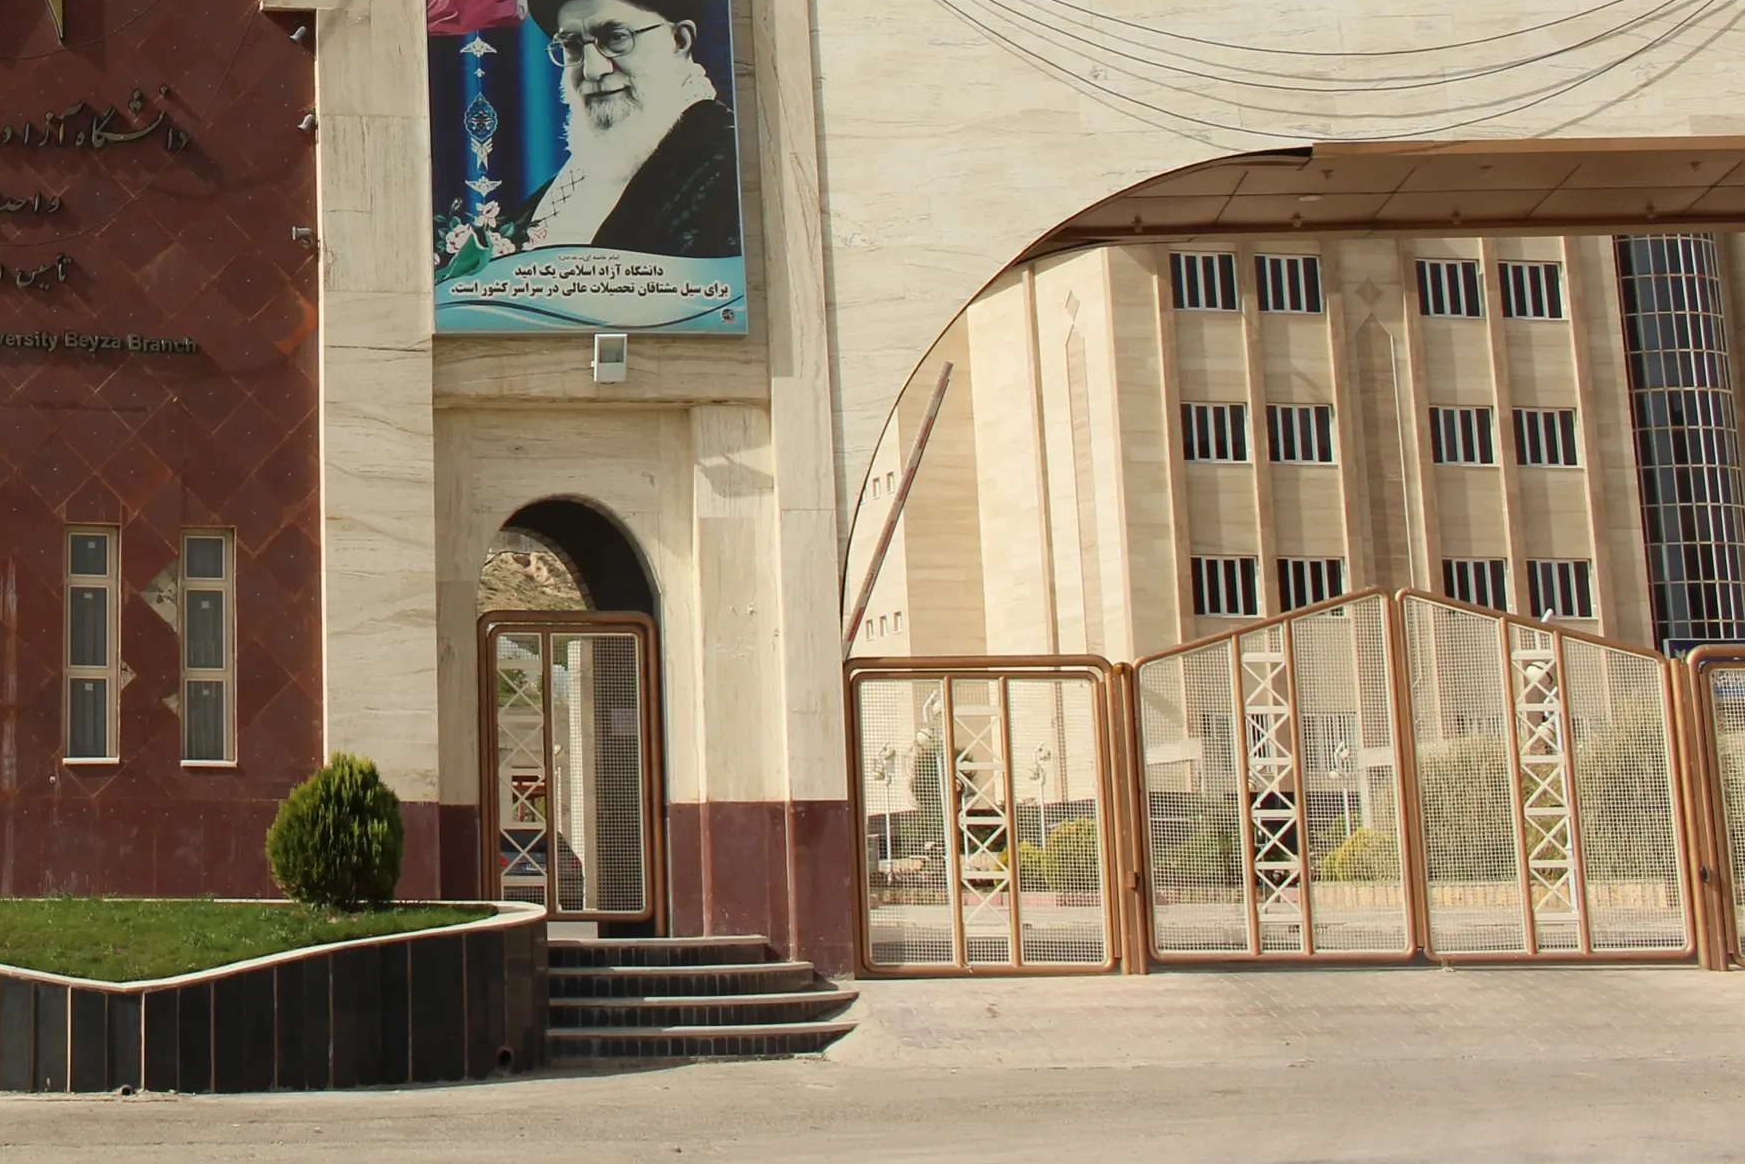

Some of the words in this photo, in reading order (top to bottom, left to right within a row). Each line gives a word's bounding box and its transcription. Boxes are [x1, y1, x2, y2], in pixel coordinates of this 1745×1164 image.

[2, 99, 86, 148] آزاد
[75, 84, 189, 151] دانشگاه
[515, 264, 536, 279] امید
[539, 265, 556, 279] یک
[559, 264, 596, 279] اسلامی
[598, 263, 622, 280] آزاد
[625, 265, 664, 277] دانشگاه
[482, 281, 508, 296] کشور
[512, 281, 543, 296] سراسر
[548, 283, 559, 296] در
[562, 281, 587, 296] عالی
[590, 281, 635, 295] تحصیلات
[637, 281, 678, 296] مشتاقان
[680, 282, 701, 297] سیل
[704, 282, 728, 297] برای
[64, 331, 122, 351] Beyza
[126, 333, 197, 353] Branch
